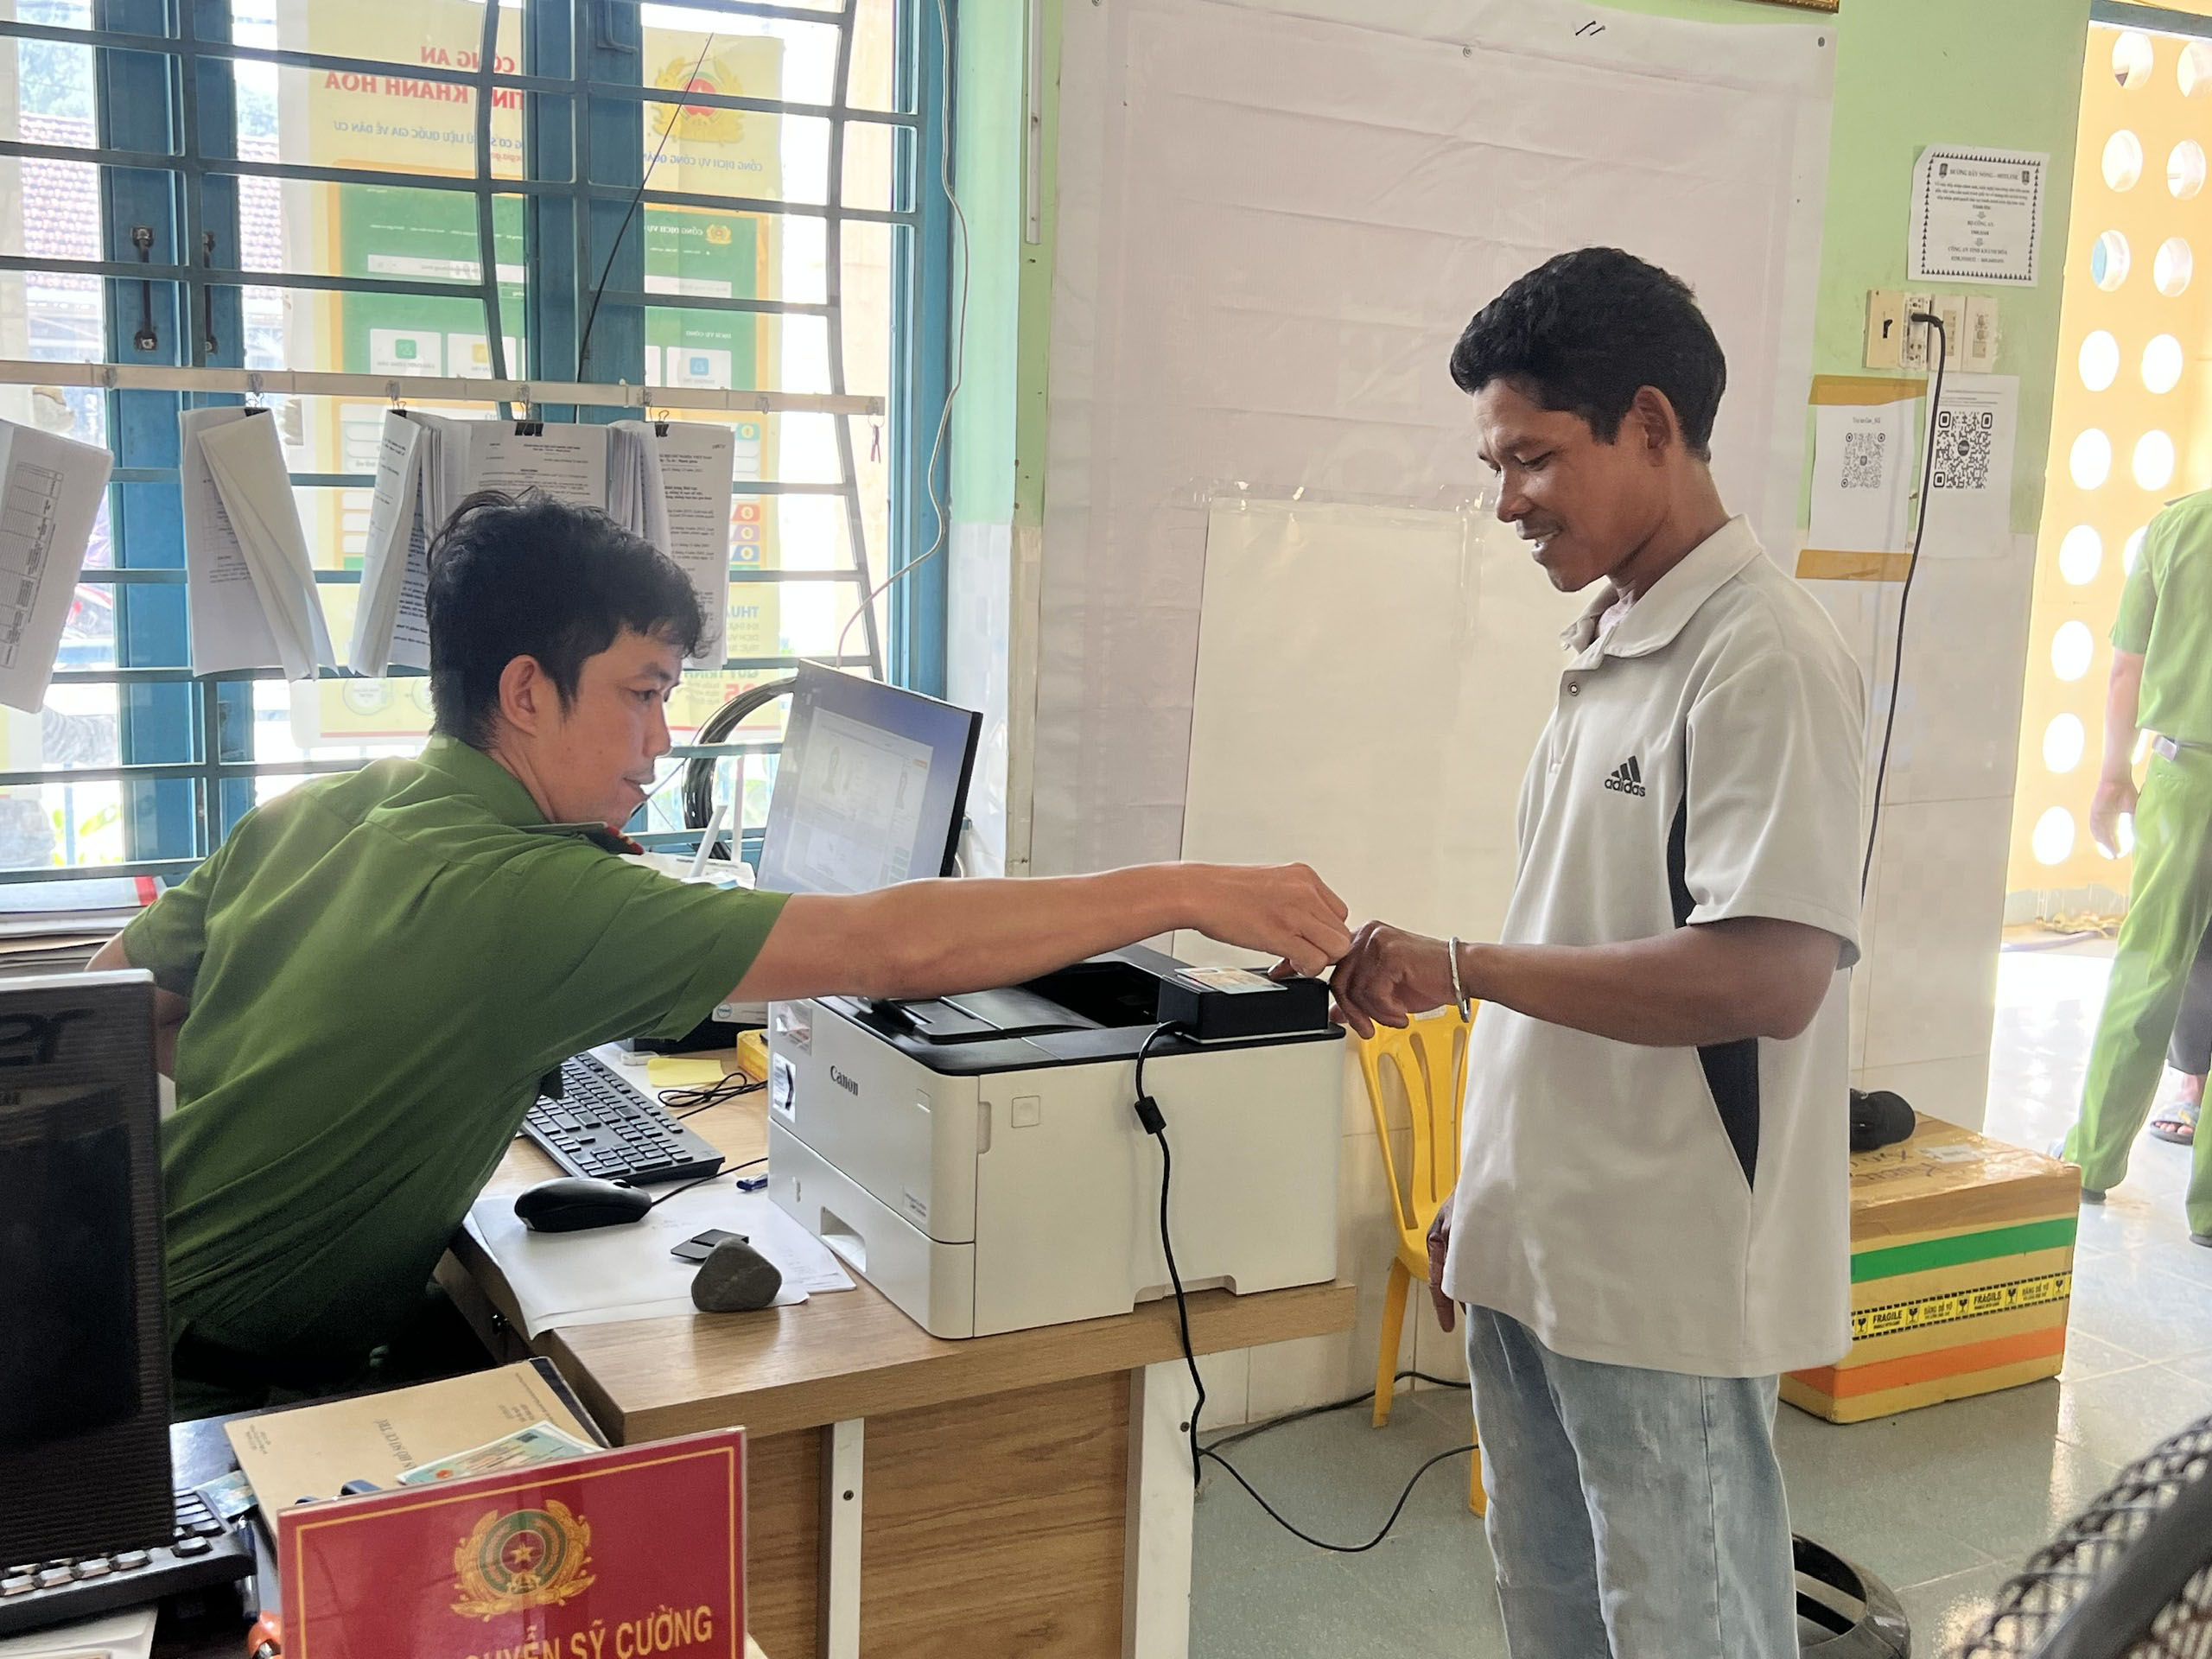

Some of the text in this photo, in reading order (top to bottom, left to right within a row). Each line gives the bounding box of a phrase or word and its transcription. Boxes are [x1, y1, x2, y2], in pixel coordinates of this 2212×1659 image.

[1604, 777, 1646, 798] adidas
[830, 1065, 859, 1096] Canon
[1974, 1291, 2001, 1305] FRAGILE
[1872, 1310, 1903, 1324] FRAGILE
[570, 1619, 606, 1659] SỸ
[616, 1605, 713, 1657] CƯỜNG
